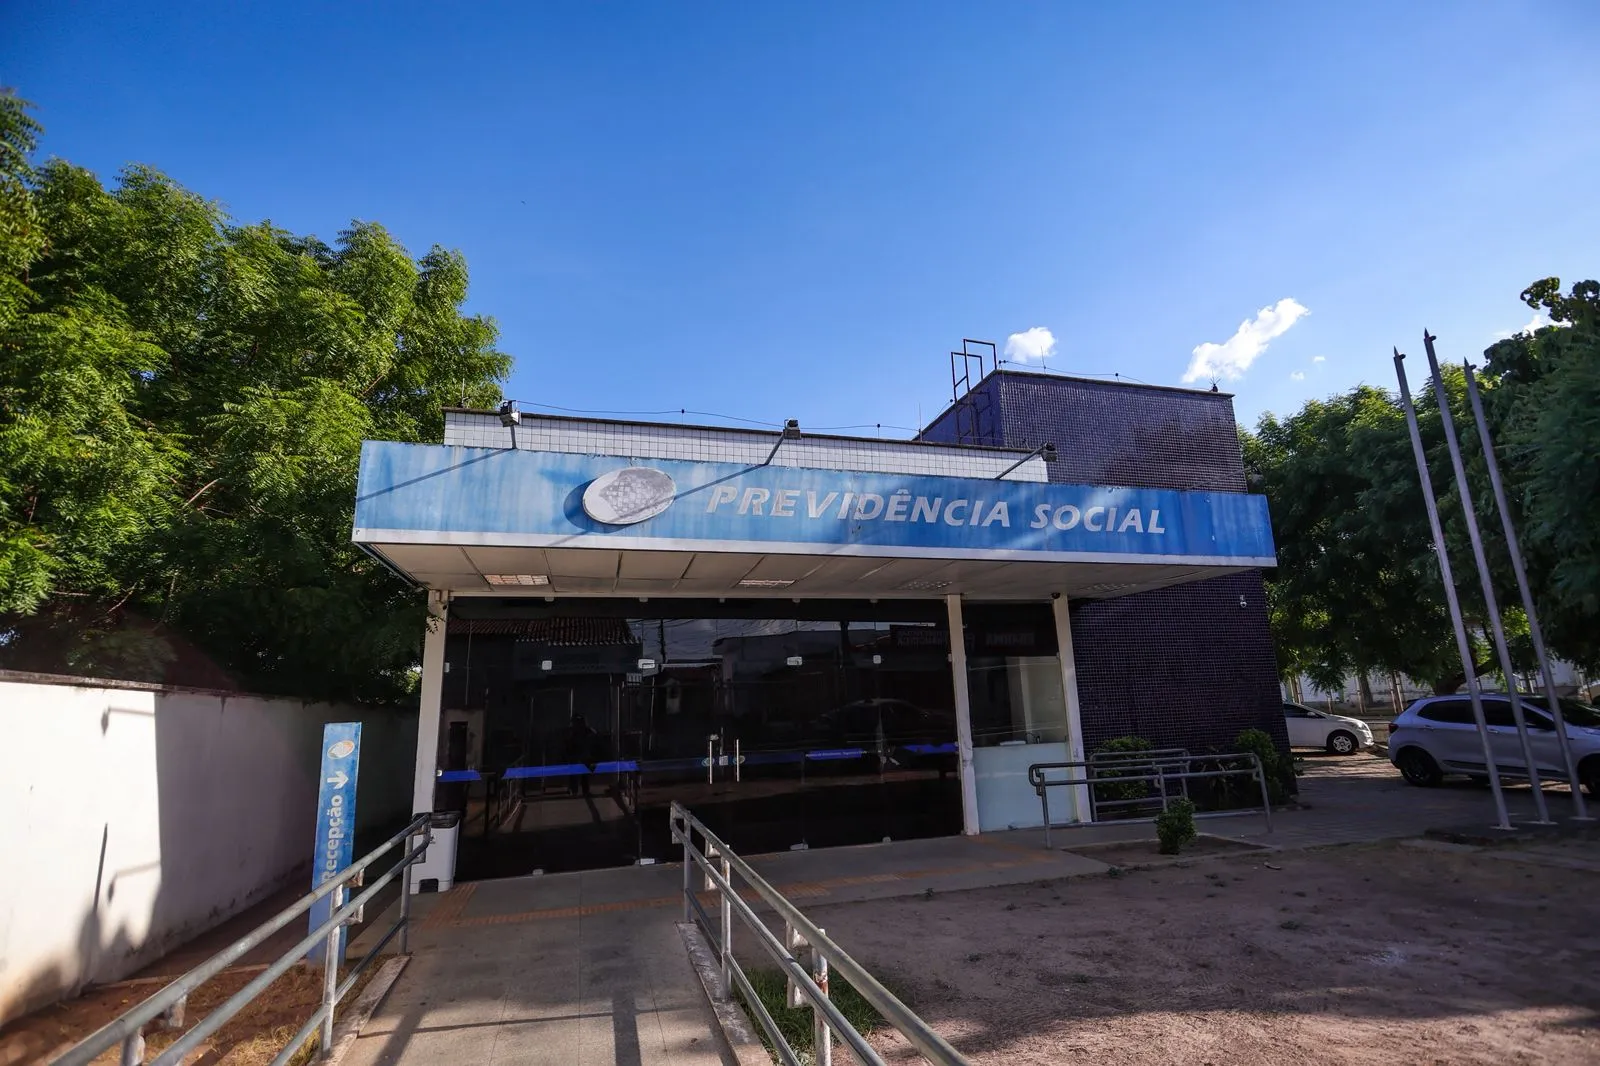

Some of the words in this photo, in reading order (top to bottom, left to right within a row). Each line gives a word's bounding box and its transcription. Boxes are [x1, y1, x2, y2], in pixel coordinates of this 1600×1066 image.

[706, 485, 1010, 528] PREVIDÊNCIA
[1030, 503, 1165, 534] SOCIAL
[322, 795, 344, 883] Recepção
